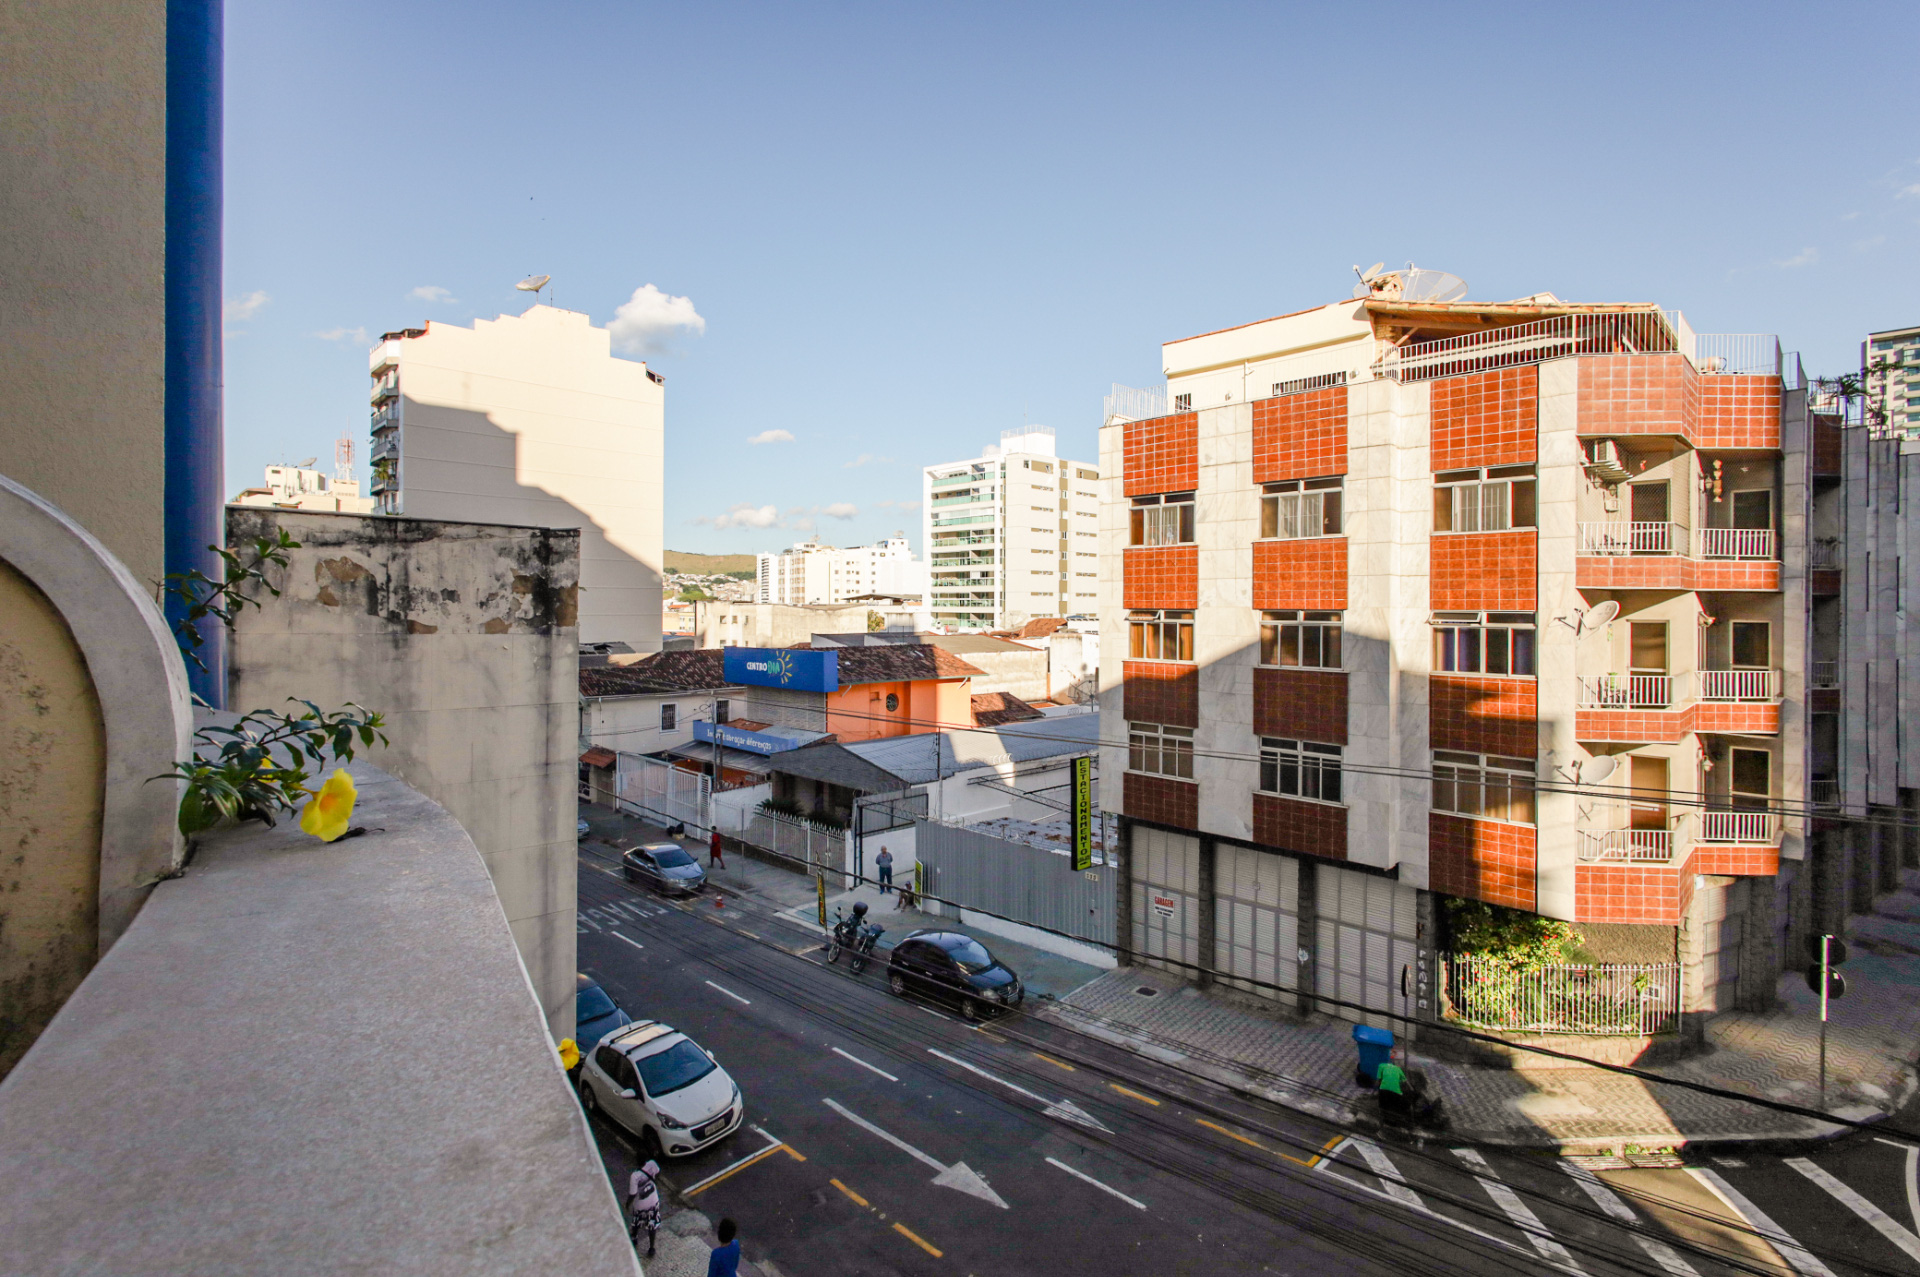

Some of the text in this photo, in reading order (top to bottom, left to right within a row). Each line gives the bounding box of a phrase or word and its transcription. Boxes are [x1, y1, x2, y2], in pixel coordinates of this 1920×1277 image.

[746, 661, 768, 672] CENTRO
[1079, 760, 1088, 856] ESTACIONAMENTO
[1154, 895, 1174, 908] GARAGEM
